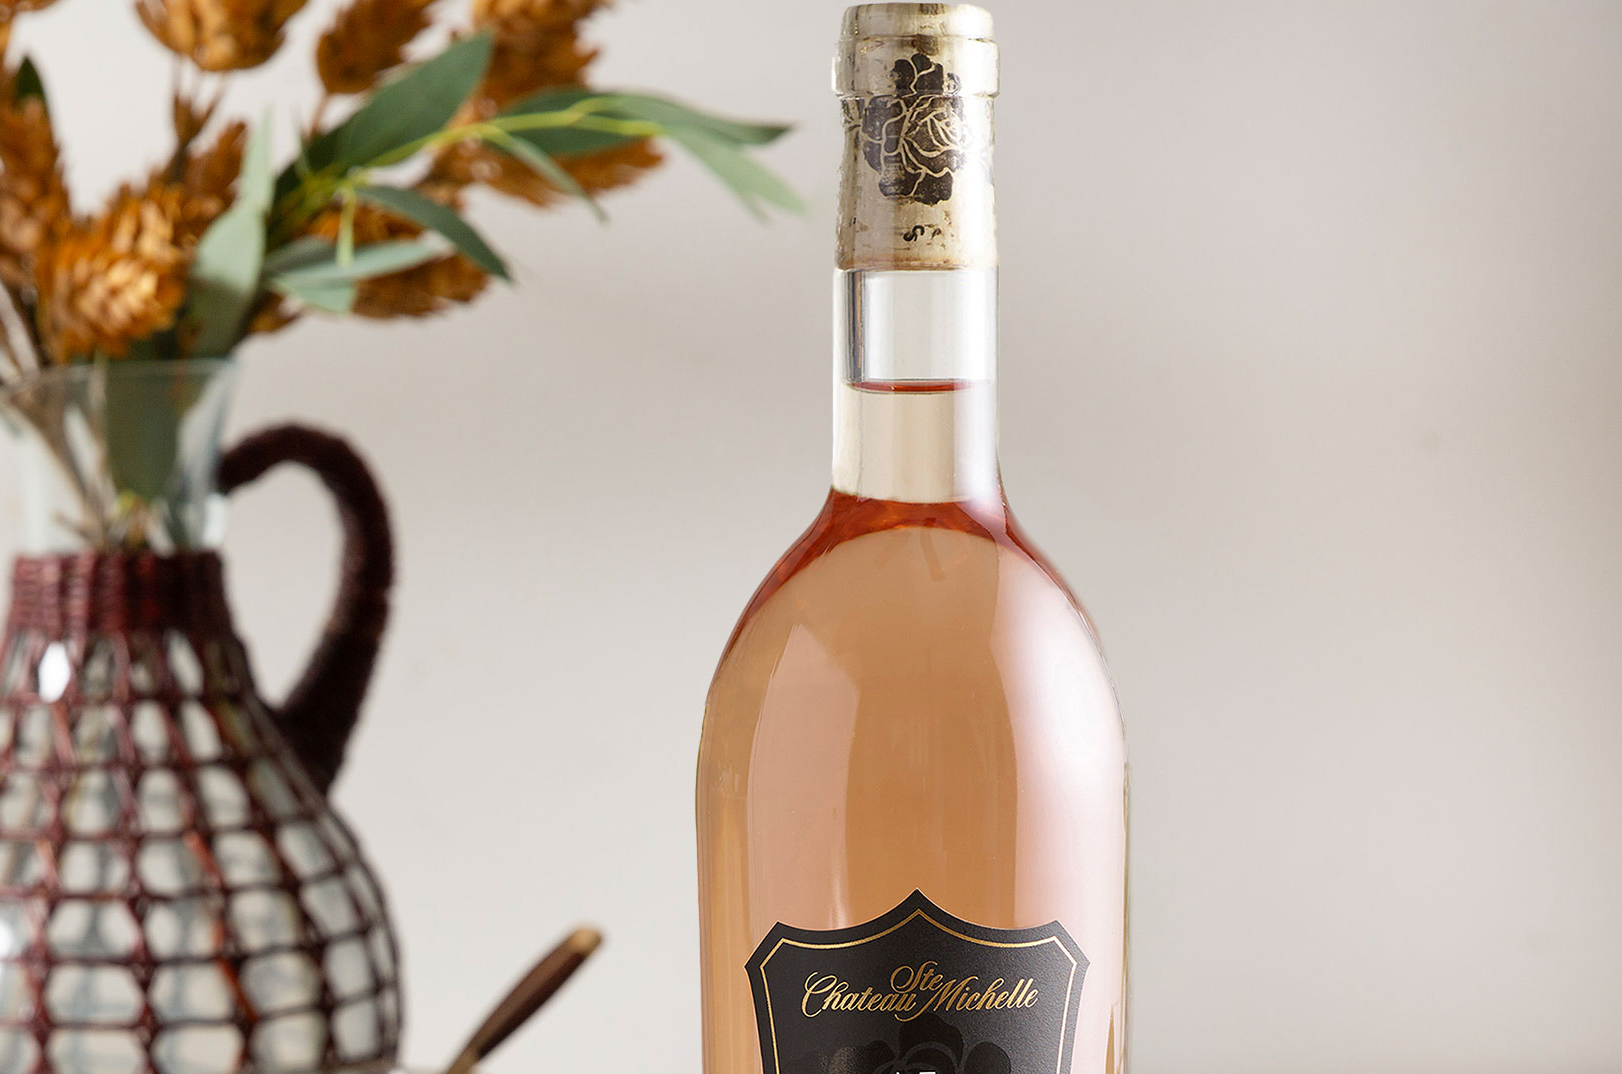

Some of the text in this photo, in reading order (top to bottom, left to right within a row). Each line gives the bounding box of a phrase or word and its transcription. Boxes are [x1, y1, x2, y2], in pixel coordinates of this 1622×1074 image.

[801, 960, 1039, 1022] Chateau Ste Michelle
